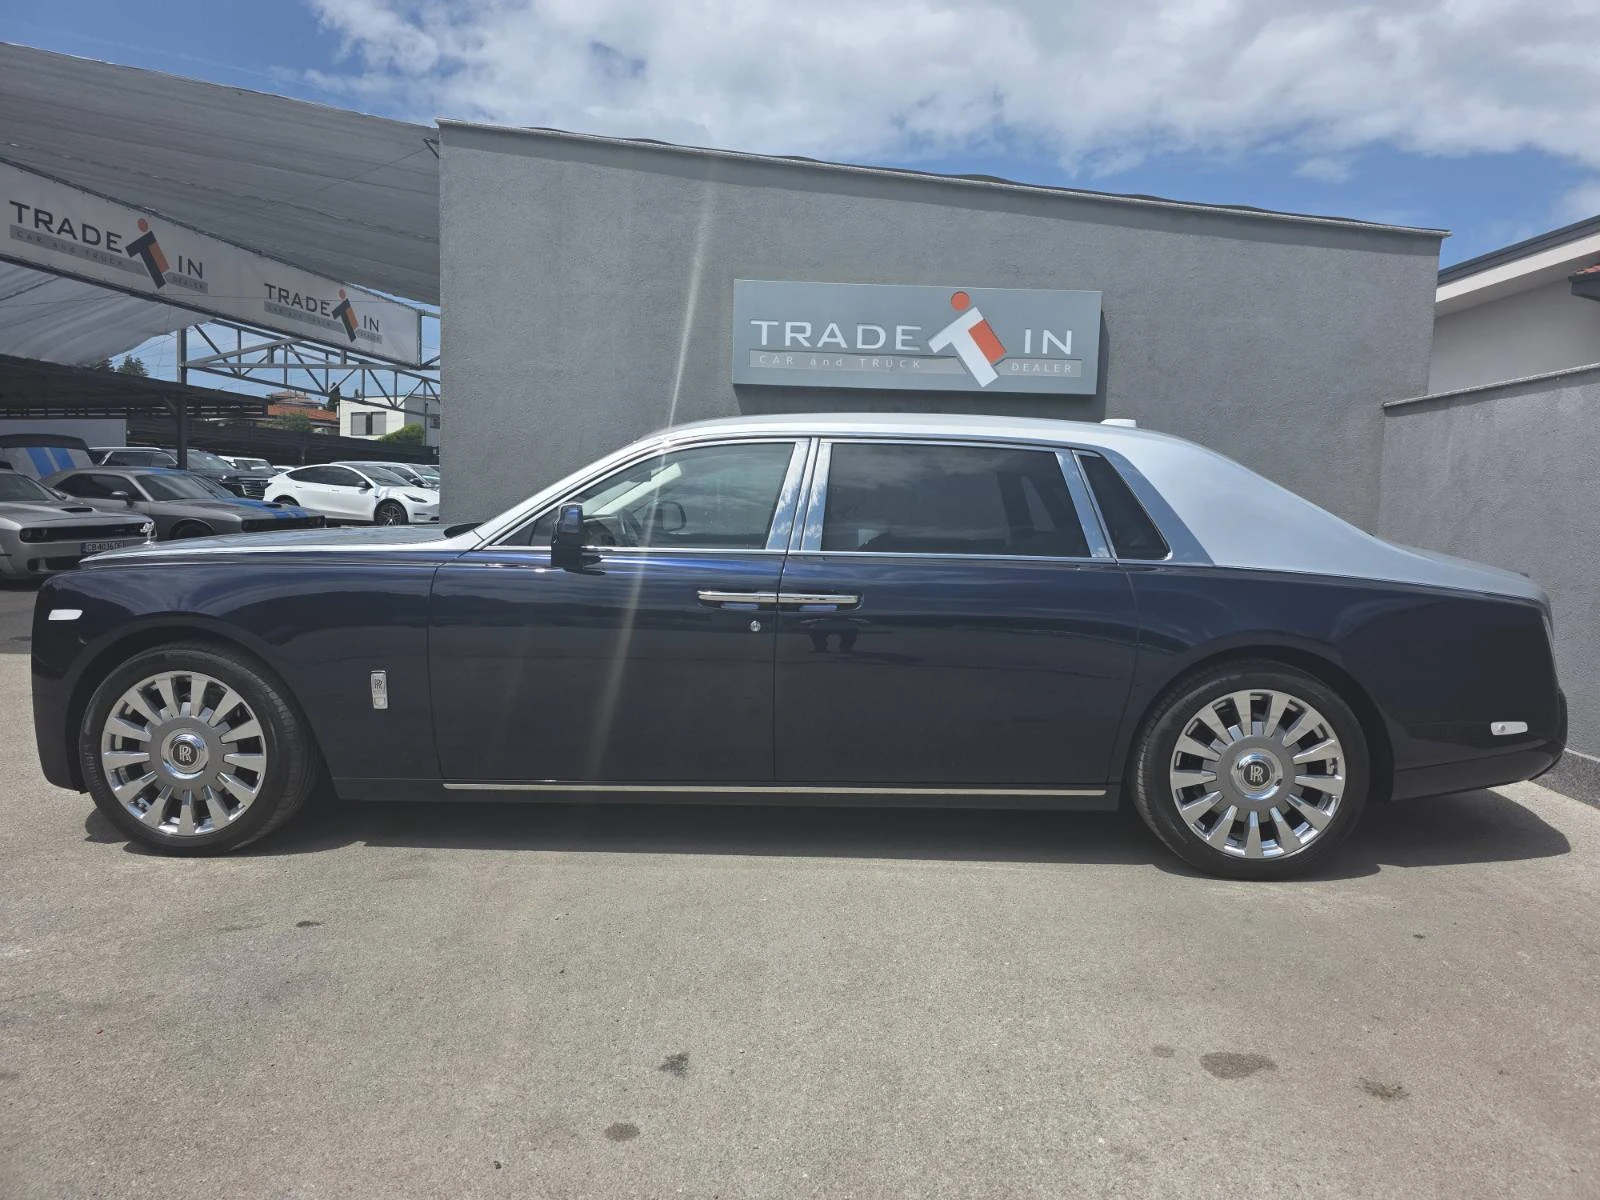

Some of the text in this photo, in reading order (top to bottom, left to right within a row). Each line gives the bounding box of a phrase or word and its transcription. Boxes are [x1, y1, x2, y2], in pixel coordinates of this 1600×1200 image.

[9, 200, 123, 253] TRADE
[178, 255, 203, 279] IN
[264, 282, 331, 317] TRADE
[363, 314, 379, 332] IN
[750, 320, 922, 351] TRADE
[1024, 328, 1072, 355] IN
[759, 355, 1072, 373] CAR and TRUCK DEALER
